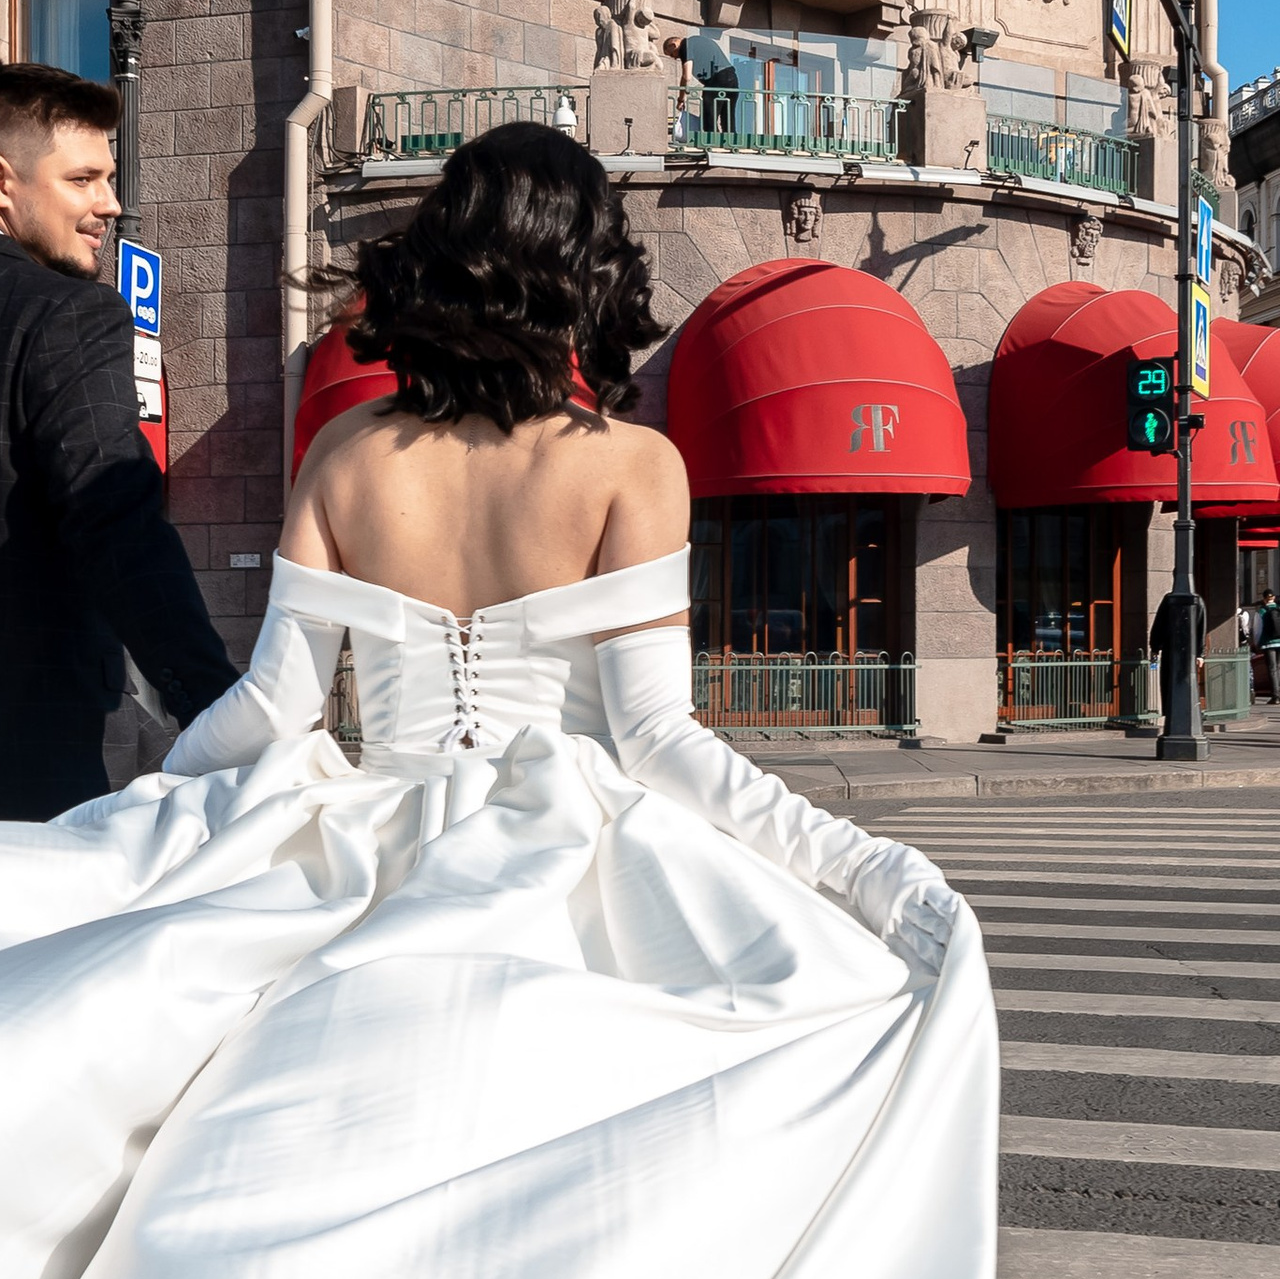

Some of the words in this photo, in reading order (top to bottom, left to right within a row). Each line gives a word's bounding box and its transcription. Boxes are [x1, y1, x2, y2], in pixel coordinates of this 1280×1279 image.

[130, 253, 154, 319] P
[134, 351, 158, 367] -20.00
[1138, 369, 1166, 395] 29
